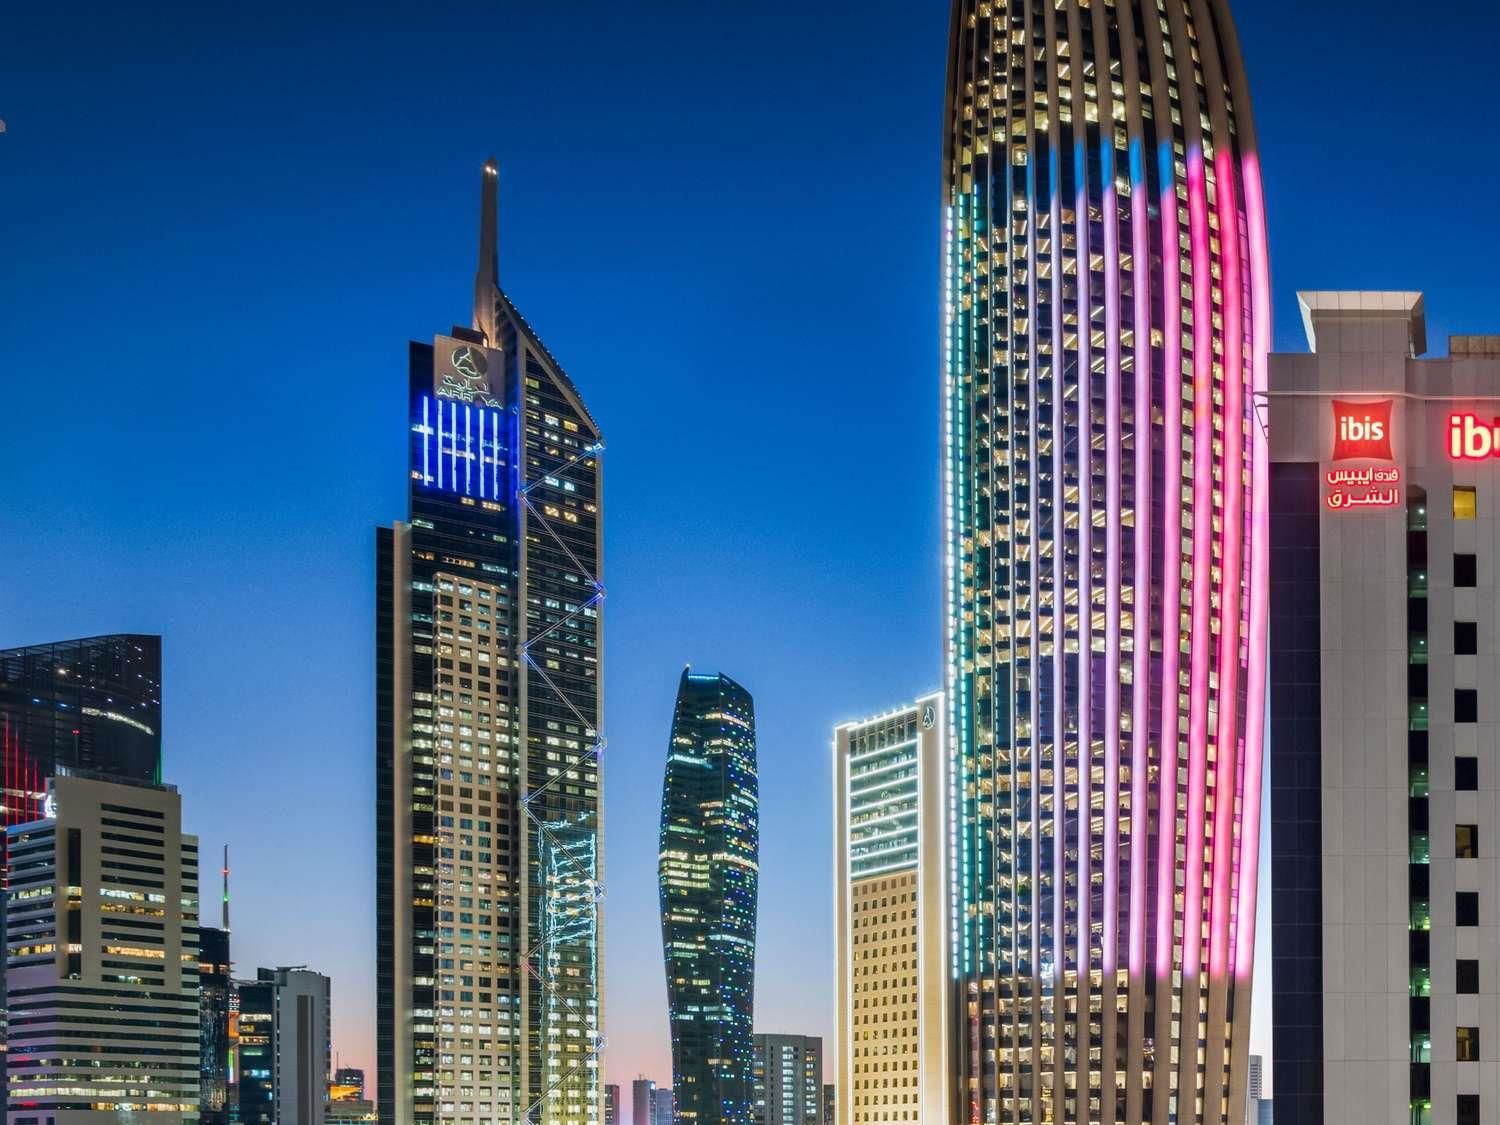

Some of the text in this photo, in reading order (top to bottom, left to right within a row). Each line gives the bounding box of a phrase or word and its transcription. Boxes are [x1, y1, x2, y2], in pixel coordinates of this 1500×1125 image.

[1340, 415, 1385, 441] ibis
[1374, 468, 1399, 482] فندق
[1327, 485, 1399, 508] الشرق
